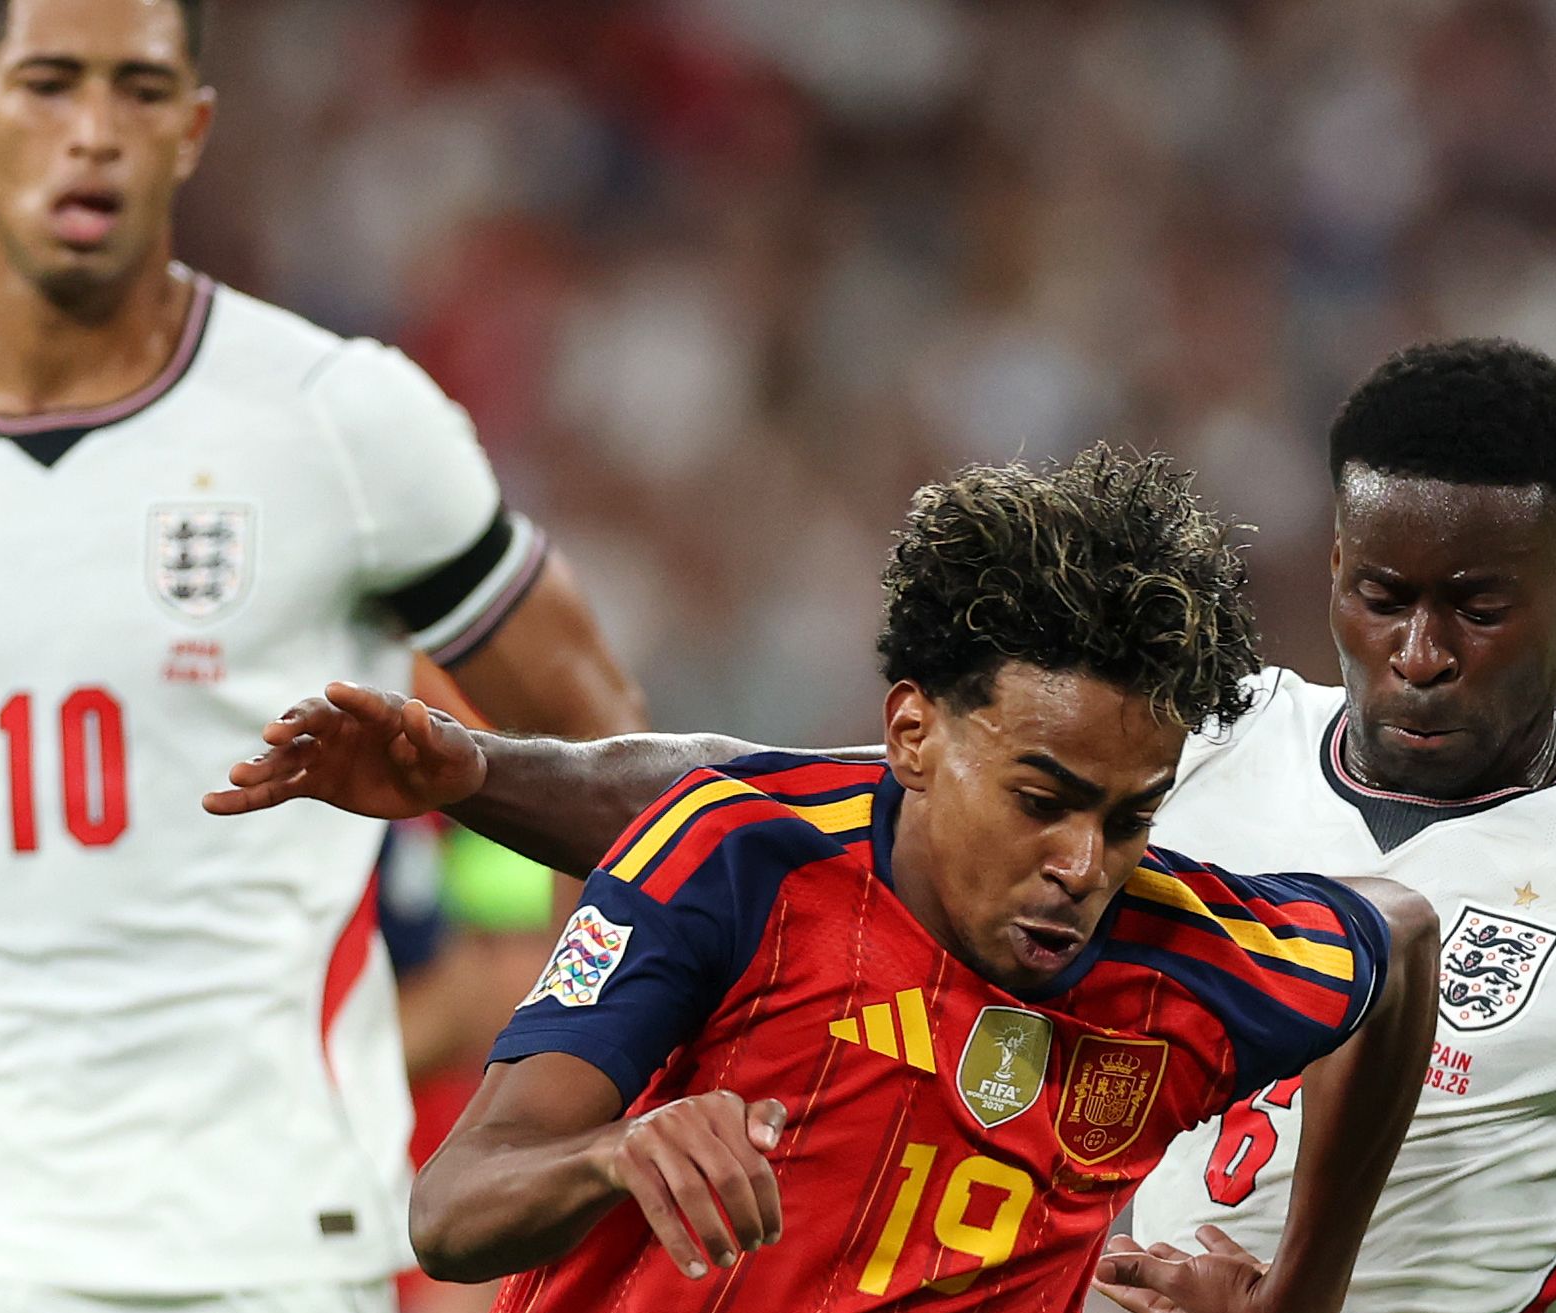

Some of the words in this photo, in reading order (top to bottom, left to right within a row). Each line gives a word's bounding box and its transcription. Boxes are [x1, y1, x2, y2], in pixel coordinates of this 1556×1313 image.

[1432, 1041, 1472, 1073] PAIN
[1424, 1066, 1469, 1095] 09.26
[857, 1142, 1034, 1296] 19
